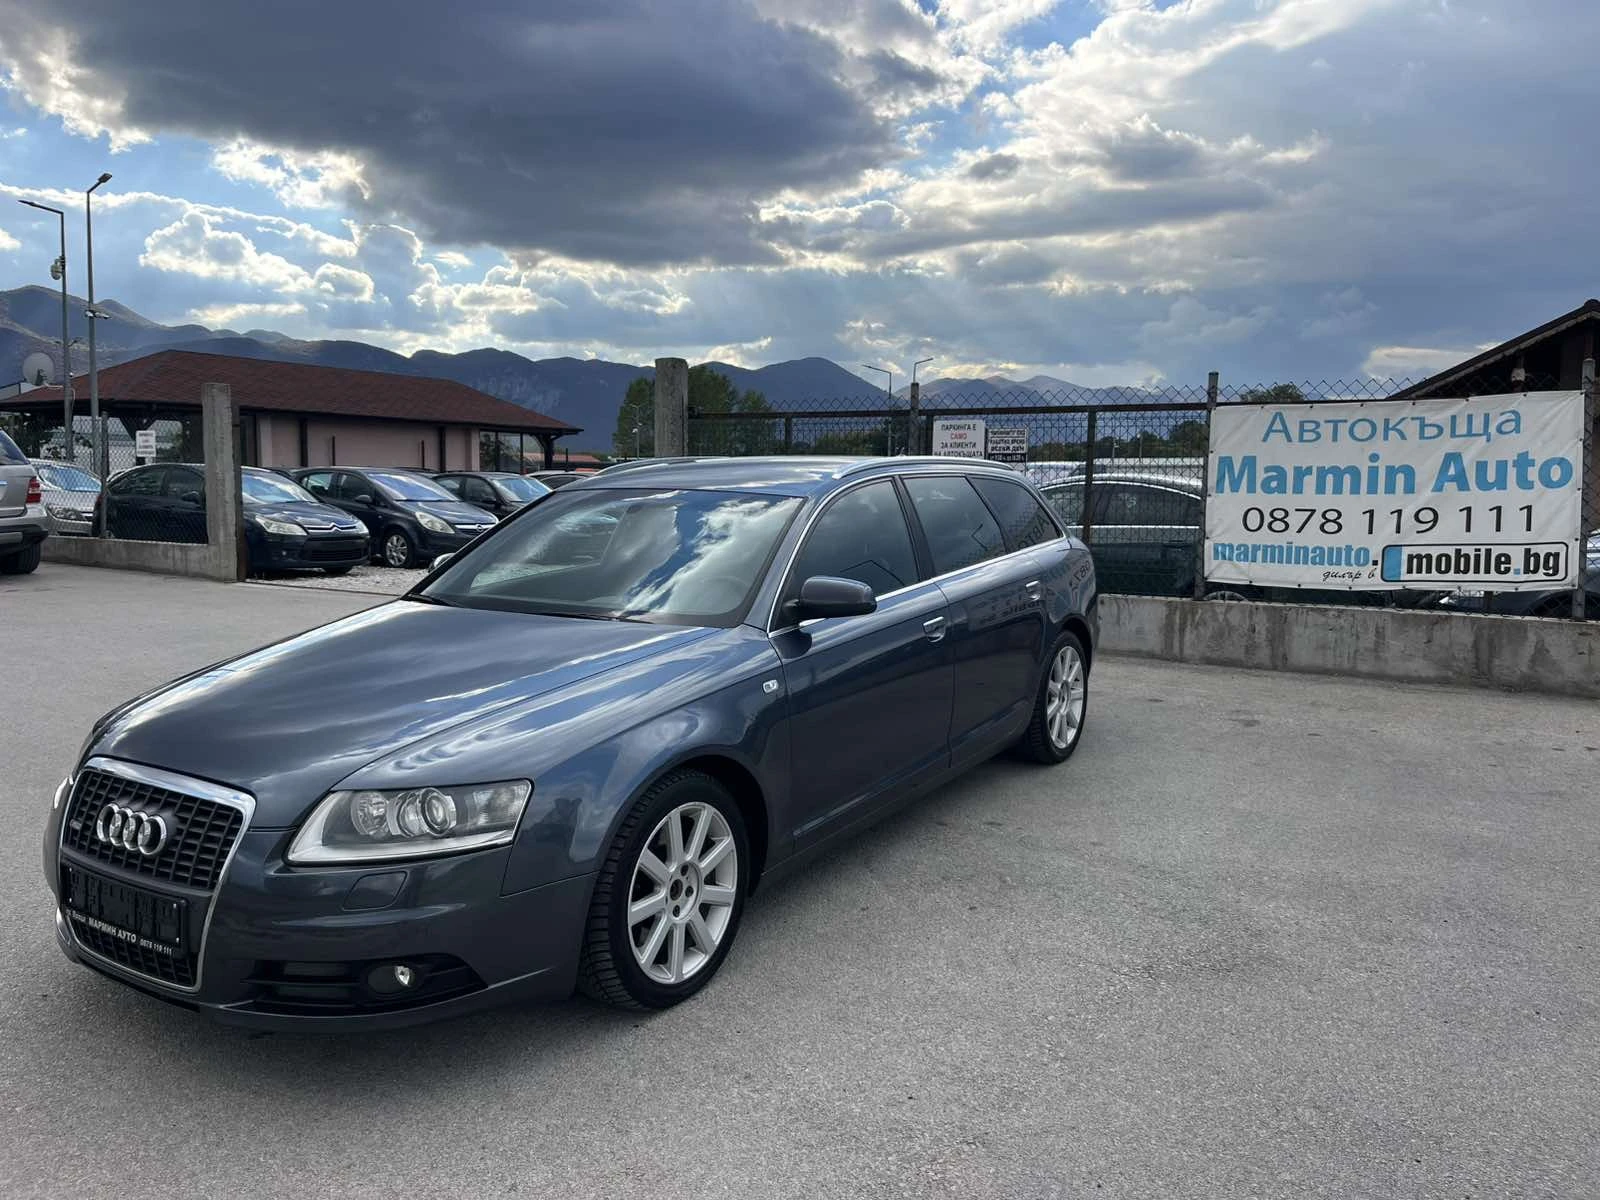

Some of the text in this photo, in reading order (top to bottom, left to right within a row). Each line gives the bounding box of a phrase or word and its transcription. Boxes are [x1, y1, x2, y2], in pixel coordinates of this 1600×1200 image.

[950, 432, 968, 440] САМО
[1261, 409, 1522, 444] Автокъща
[940, 441, 977, 449] ЗА КЛИЕНТИ
[1215, 450, 1574, 496] Marmin Auto
[1241, 504, 1534, 535] 0878 119 111
[1322, 567, 1377, 582] дилър в
[1406, 547, 1561, 577] mobile.bg
[88, 916, 117, 937] МАРМИН
[117, 929, 137, 943] АУТО
